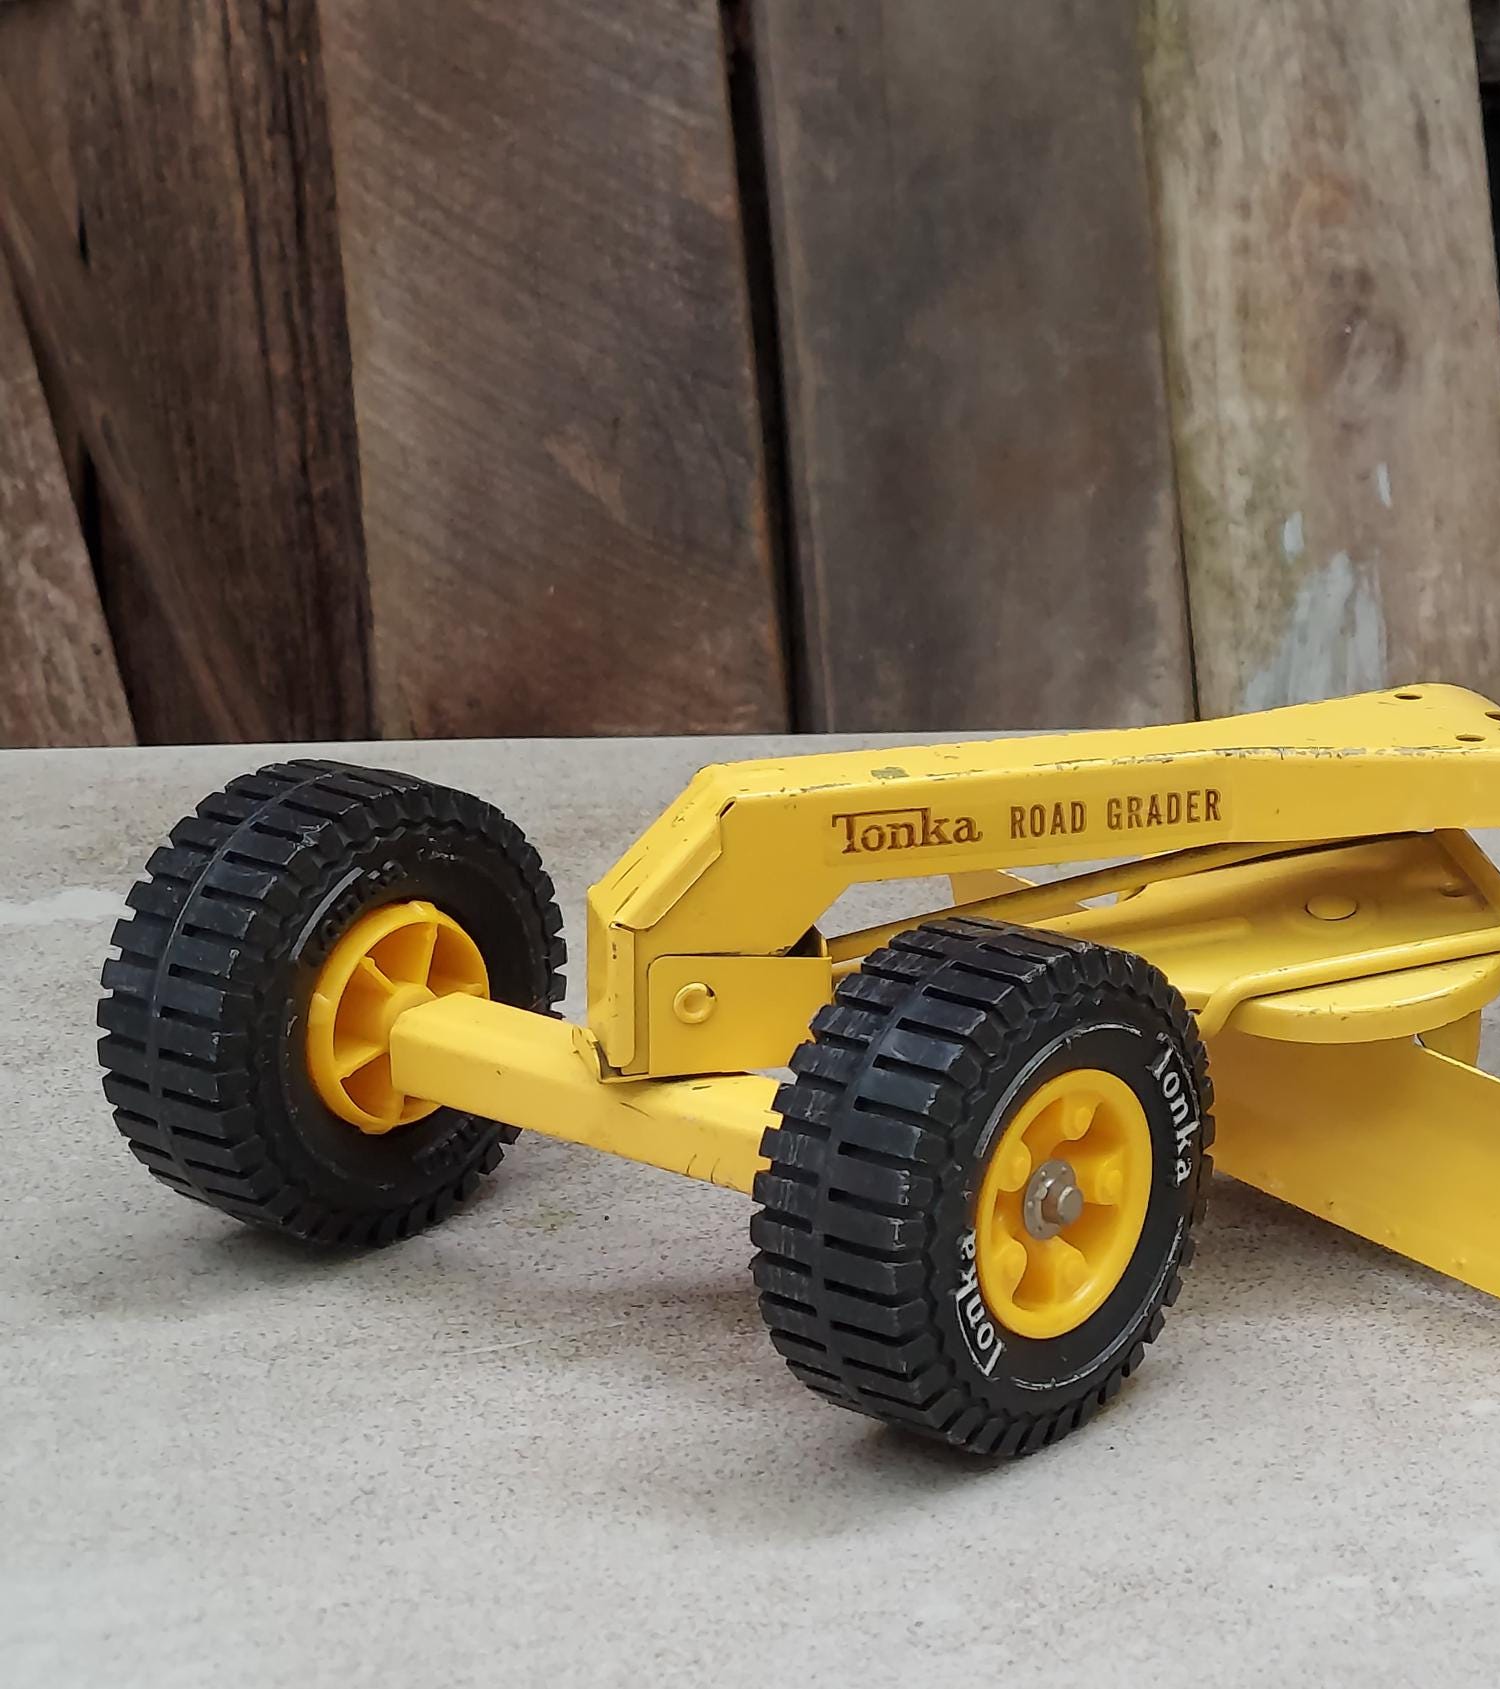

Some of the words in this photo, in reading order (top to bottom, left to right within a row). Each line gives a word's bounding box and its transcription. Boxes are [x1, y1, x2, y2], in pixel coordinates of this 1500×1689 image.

[831, 806, 984, 855] Tonka
[1009, 800, 1088, 840] ROAD
[1106, 788, 1223, 831] GRADER
[1145, 1032, 1200, 1188] Tonka
[954, 1227, 1008, 1380] Tonka
